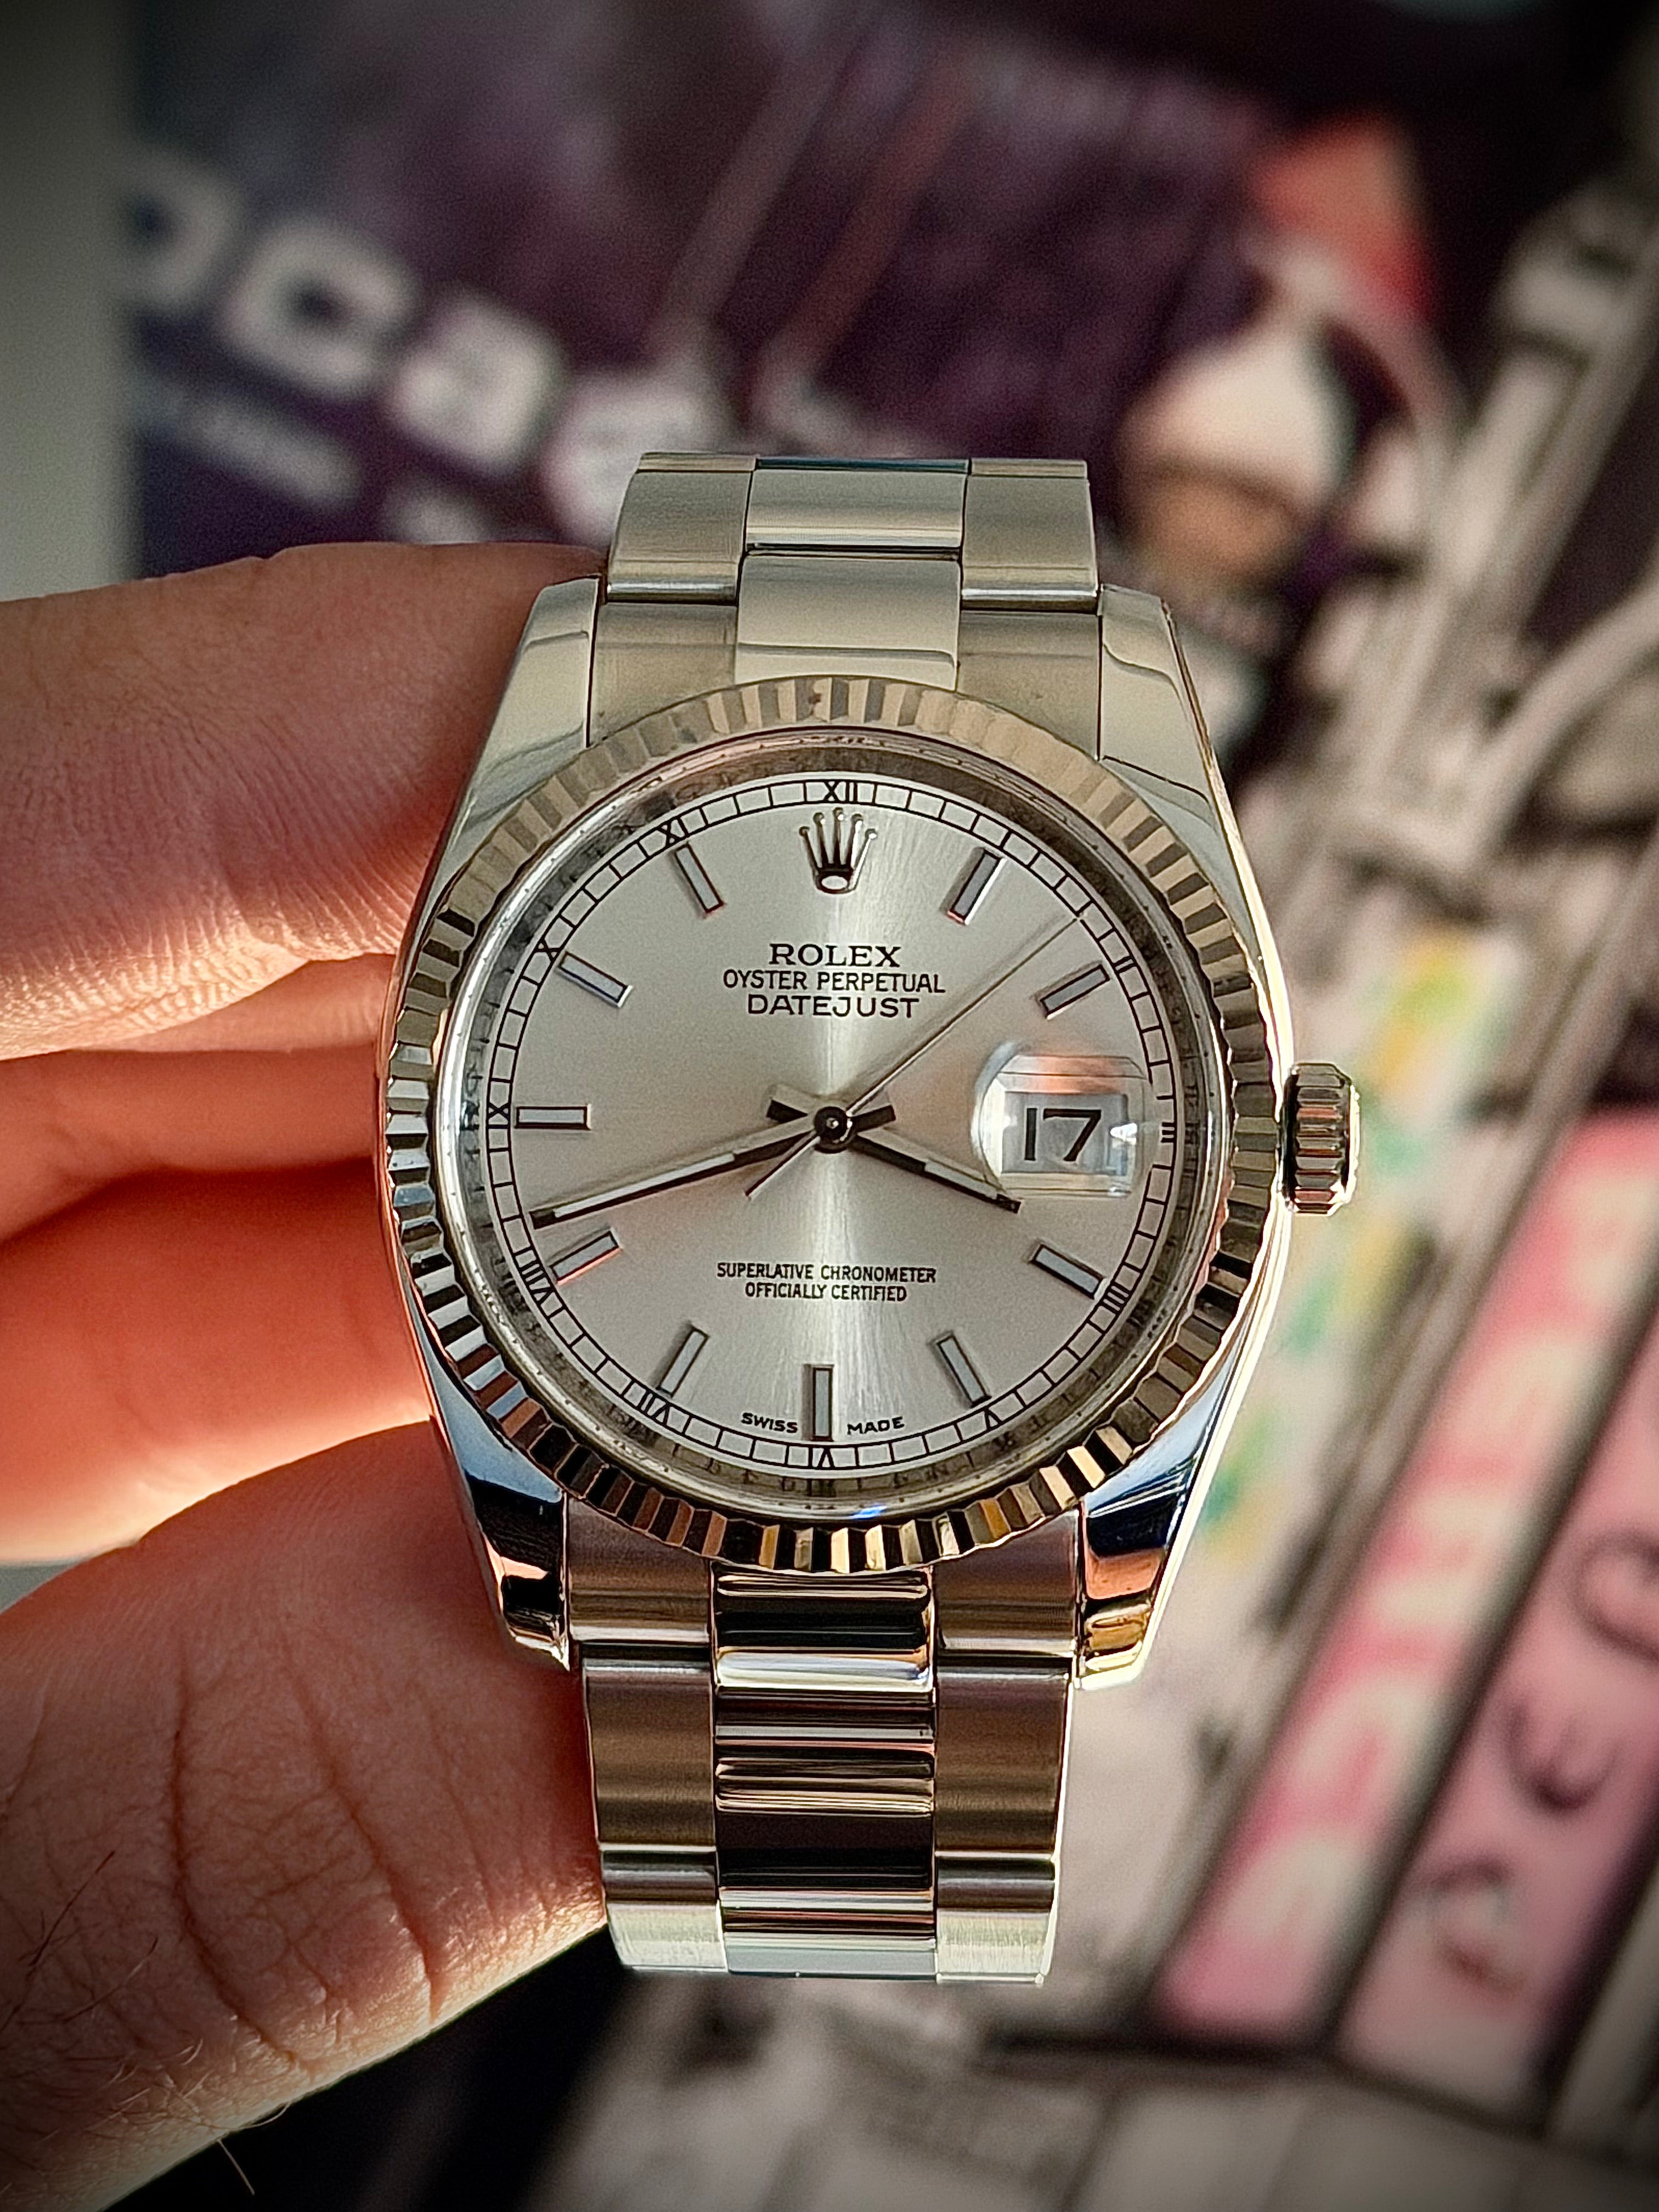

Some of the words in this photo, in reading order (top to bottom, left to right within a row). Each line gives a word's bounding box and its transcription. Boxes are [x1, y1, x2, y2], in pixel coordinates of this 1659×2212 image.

[823, 779, 857, 803] XII
[769, 943, 901, 968] ROLEX
[723, 969, 808, 990] OYSTER
[817, 972, 946, 993] PERPETUAL
[747, 994, 919, 1018] DATEJUST
[1024, 1107, 1102, 1162] 17
[716, 1262, 814, 1279] SUPERLATIVE
[821, 1265, 936, 1283] CHRONOMETER
[745, 1282, 827, 1299] OFFICIALLY
[831, 1285, 907, 1301] CERTIFIED
[741, 1412, 798, 1434] SWISS
[847, 1416, 905, 1435] MADE
